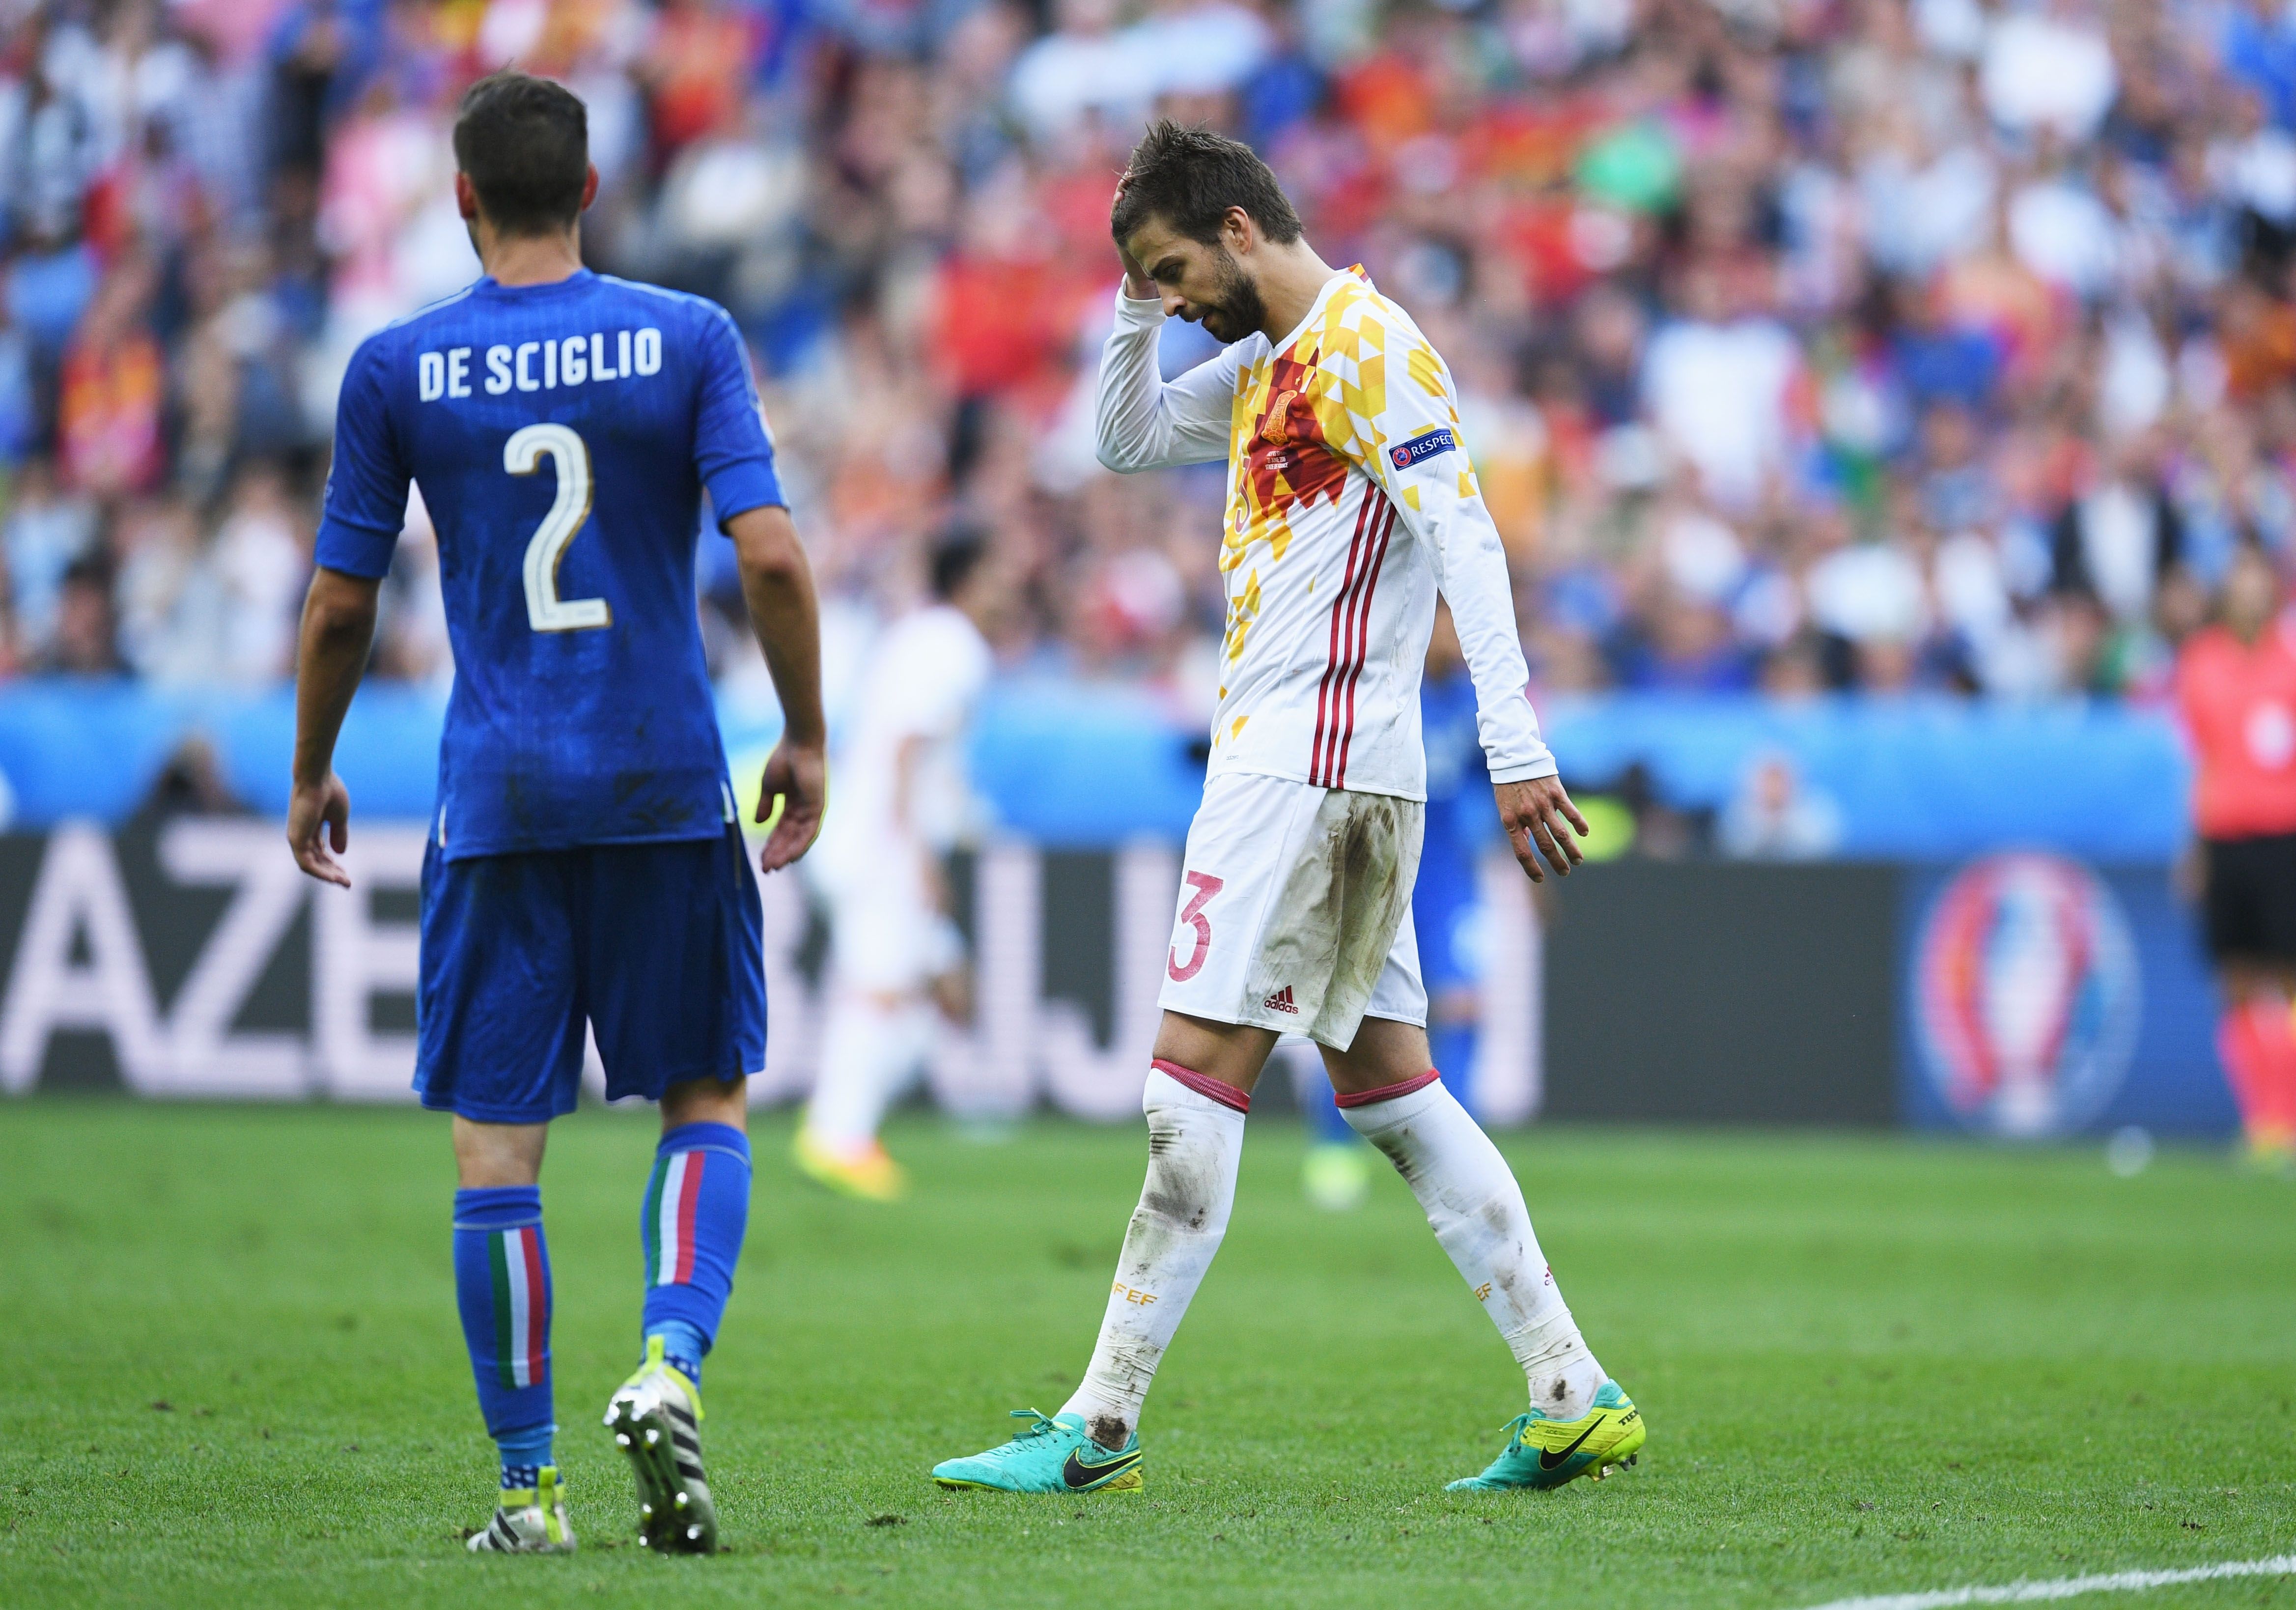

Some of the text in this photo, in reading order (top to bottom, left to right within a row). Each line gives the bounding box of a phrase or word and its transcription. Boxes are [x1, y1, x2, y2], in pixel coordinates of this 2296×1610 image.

[419, 327, 662, 402] DE SCIGLIO
[1411, 435, 1454, 457] RESPECT
[503, 422, 614, 633] 2
[1168, 870, 1224, 982] 3
[1264, 999, 1299, 1015] adidas
